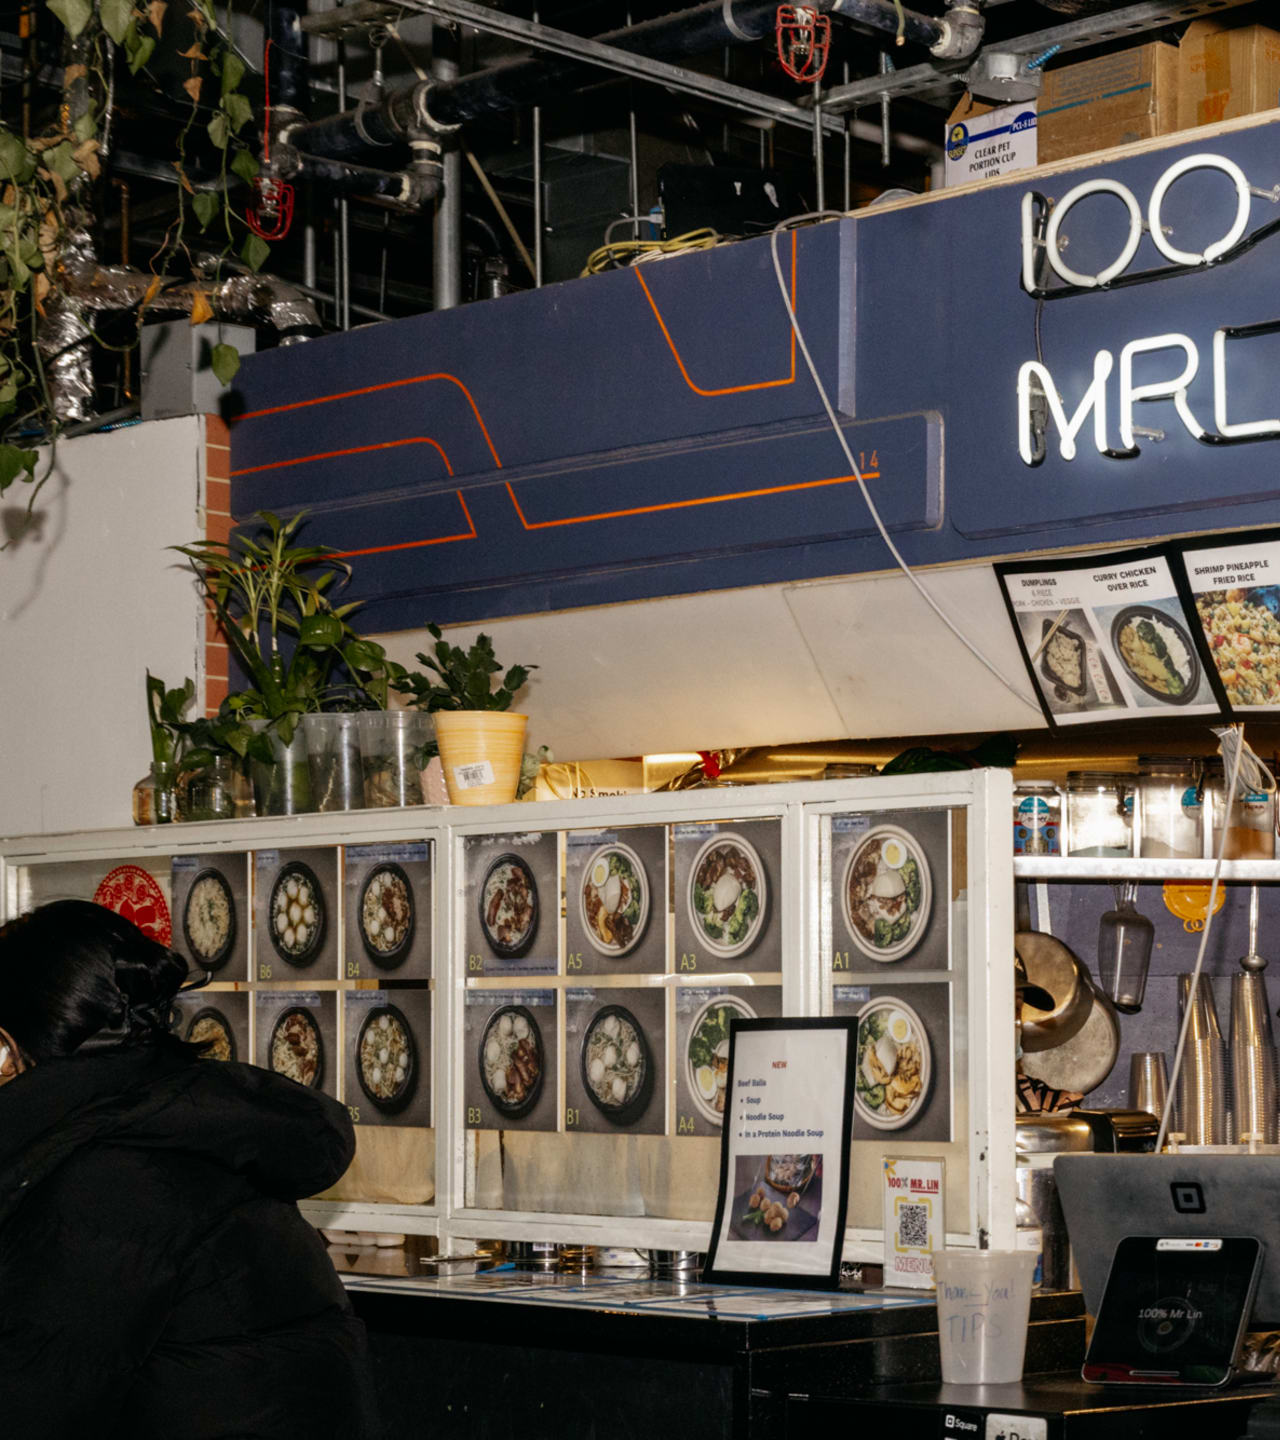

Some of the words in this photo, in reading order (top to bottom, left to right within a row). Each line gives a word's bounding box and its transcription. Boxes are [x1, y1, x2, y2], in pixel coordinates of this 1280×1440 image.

[974, 146, 997, 159] CLEAR
[998, 141, 1012, 153] PET
[969, 155, 1000, 172] PORTION
[1001, 151, 1016, 164] CUP
[1093, 571, 1117, 583] CURRY
[1119, 565, 1157, 580] CHICKEN
[1194, 564, 1224, 576] SHRIMP
[1225, 560, 1270, 573] PINEAPPLE
[1021, 578, 1057, 588] DUMPLINGS
[1107, 582, 1127, 592] OVER
[1129, 579, 1148, 590] RICE
[1213, 575, 1236, 585] FRIED
[1237, 573, 1255, 583] RICE
[347, 961, 360, 977] B4
[469, 954, 483, 972] B2
[567, 953, 583, 970] A5
[680, 954, 697, 971] A3
[833, 951, 851, 970] A1
[259, 963, 273, 980] B6
[771, 1060, 788, 1070] NEW
[746, 1096, 762, 1106] Soup
[468, 1108, 481, 1125] B3
[566, 1107, 580, 1126] B1
[678, 1116, 695, 1134] A4
[745, 1112, 766, 1121] Noodle
[768, 1112, 785, 1123] Soup
[758, 1129, 781, 1138] Protein
[782, 1128, 805, 1137] Noodle
[806, 1128, 824, 1139] Soup
[910, 1178, 925, 1190] MR.
[926, 1178, 939, 1190] LIN
[895, 1257, 934, 1274] MENU
[1170, 1308, 1184, 1318] Mr
[1187, 1308, 1203, 1320] Lin
[945, 1312, 1001, 1343] TIPS
[955, 1418, 978, 1432] Square
